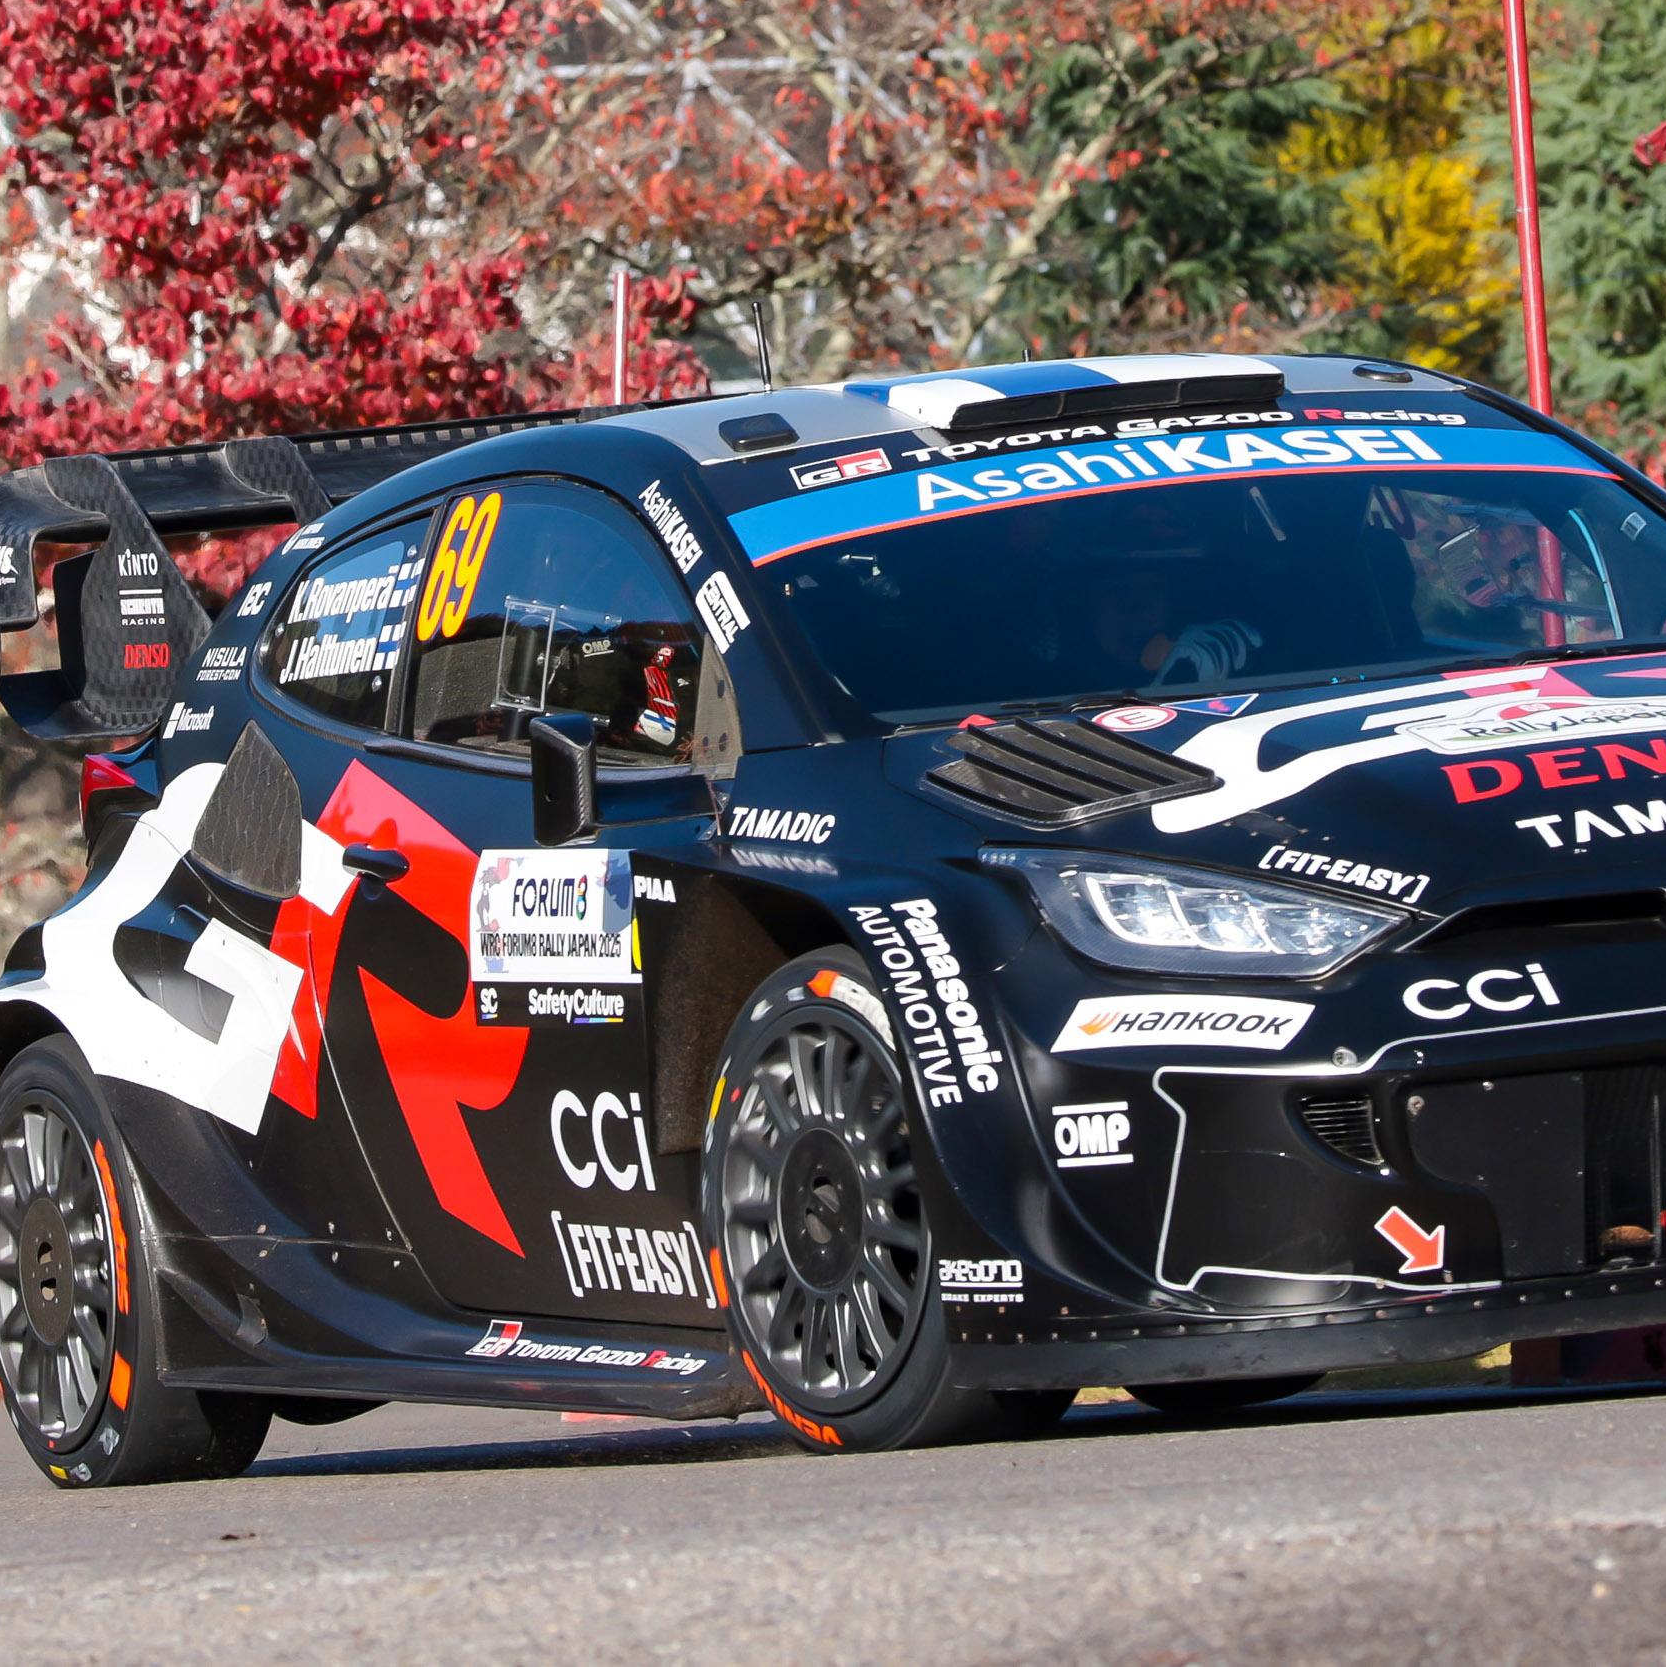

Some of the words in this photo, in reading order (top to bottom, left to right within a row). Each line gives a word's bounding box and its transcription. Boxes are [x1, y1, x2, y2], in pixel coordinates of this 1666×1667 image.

[799, 457, 884, 485] GR
[902, 425, 1106, 462] TOYOTA
[1116, 410, 1294, 432] GAZOO
[1303, 409, 1466, 426] Racing
[916, 429, 1443, 511] AsahiKASEI
[638, 479, 703, 575] AsahiKASEI
[416, 492, 503, 642] 69
[121, 617, 166, 626] RACING
[701, 577, 739, 644] CENTRAL
[124, 642, 171, 670] DENSO
[201, 645, 247, 668] NISULA
[279, 633, 378, 685] J.Halttunen
[582, 639, 611, 654] OMP
[176, 704, 215, 732] Microsoft
[728, 807, 835, 844] TAMADIC
[512, 875, 588, 920] FORUM8
[634, 875, 677, 903] PIAA
[480, 933, 501, 957] WRC
[502, 933, 536, 957] FORUM8
[538, 934, 564, 957] RALLY
[567, 934, 597, 957] JAPAN
[598, 934, 621, 958] 2025
[480, 987, 499, 1014] SC
[528, 987, 625, 1024] SafetyCulture
[848, 906, 964, 1108] AUTOMOTIVE
[890, 898, 1002, 1093] Panasonic
[1054, 1112, 1131, 1156] OMP
[973, 1293, 1025, 1303] EXPERTS
[508, 1339, 576, 1361] TOYOTA
[578, 1345, 647, 1367] GAZOO
[640, 1350, 708, 1375] Racing
